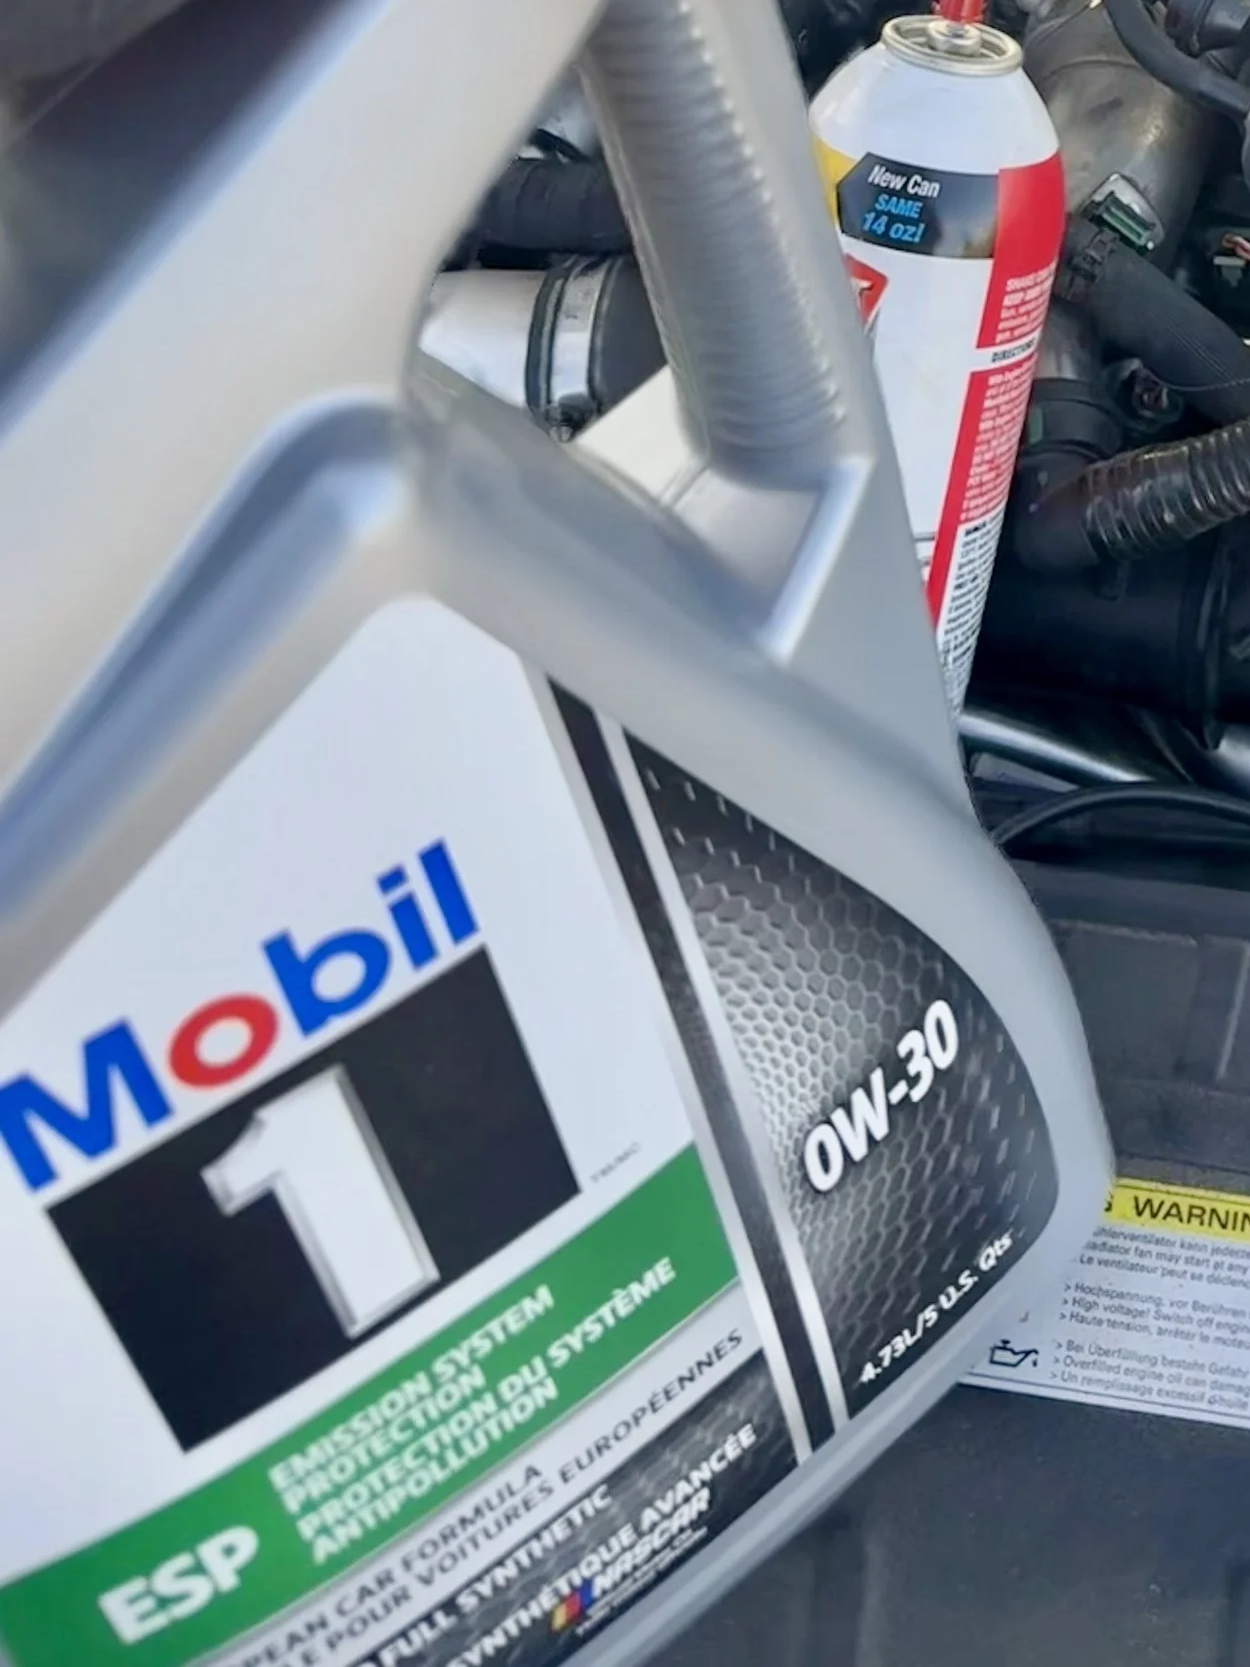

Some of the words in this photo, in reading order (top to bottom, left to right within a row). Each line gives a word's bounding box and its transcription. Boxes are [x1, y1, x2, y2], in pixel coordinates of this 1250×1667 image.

[861, 212, 889, 236] 14
[889, 222, 926, 243] oz!
[868, 164, 906, 191] New
[907, 174, 941, 198] Can
[874, 194, 923, 219] SAME
[0, 836, 480, 1195] Mobil
[803, 998, 960, 1193] 0W-30
[200, 1063, 441, 1341] 1
[938, 1268, 979, 1310] U.S.
[978, 1228, 1014, 1272] Qts
[1071, 1297, 1100, 1312] High
[1152, 1309, 1193, 1325] Switch
[1196, 1316, 1213, 1328] off
[1079, 1253, 1093, 1264] Le
[1093, 1256, 1158, 1274] ventilateur
[1160, 1266, 1186, 1280] peut
[1190, 1272, 1203, 1282] se
[1132, 1246, 1153, 1259] fan
[1155, 1251, 1180, 1265] may
[1183, 1255, 1209, 1268] start
[1212, 1260, 1225, 1270] at
[1226, 1263, 1249, 1275] any
[1169, 1298, 1188, 1310] vor
[1062, 1355, 1121, 1375] Overfilled
[1122, 1366, 1164, 1383] engine
[1166, 1371, 1183, 1385] oil
[1185, 1376, 1206, 1389] can
[1065, 1340, 1085, 1354] Bei
[1160, 1355, 1205, 1373] besteht
[1207, 1361, 1249, 1379] Gefahr
[1068, 1312, 1104, 1327] Haute
[1198, 1332, 1210, 1343] le
[268, 1371, 432, 1493] EMISSION
[432, 1283, 554, 1383] SYSTEM
[281, 1365, 486, 1516] PROTECTION
[297, 1393, 498, 1543] PROTECTION
[497, 1356, 547, 1403] DU
[547, 1255, 677, 1368] SYSTÈME
[1060, 1370, 1077, 1383] Un
[1080, 1374, 1153, 1397] remplissage
[1155, 1385, 1206, 1403] excessif
[313, 1377, 559, 1565] ANTIPOLLUTION
[325, 1584, 411, 1652] POUR
[416, 1478, 555, 1587] VOITURES
[558, 1327, 743, 1484] EUROPÉENNES
[640, 1424, 757, 1534] AVANCÉE
[97, 1525, 260, 1646] ESP
[241, 1613, 328, 1667] PEAN
[335, 1568, 395, 1618] CAR
[400, 1464, 542, 1574] FORMULA
[377, 1608, 458, 1667] FULL
[455, 1484, 613, 1615] SYNTHETIC
[591, 1486, 711, 1599] NASCAR
